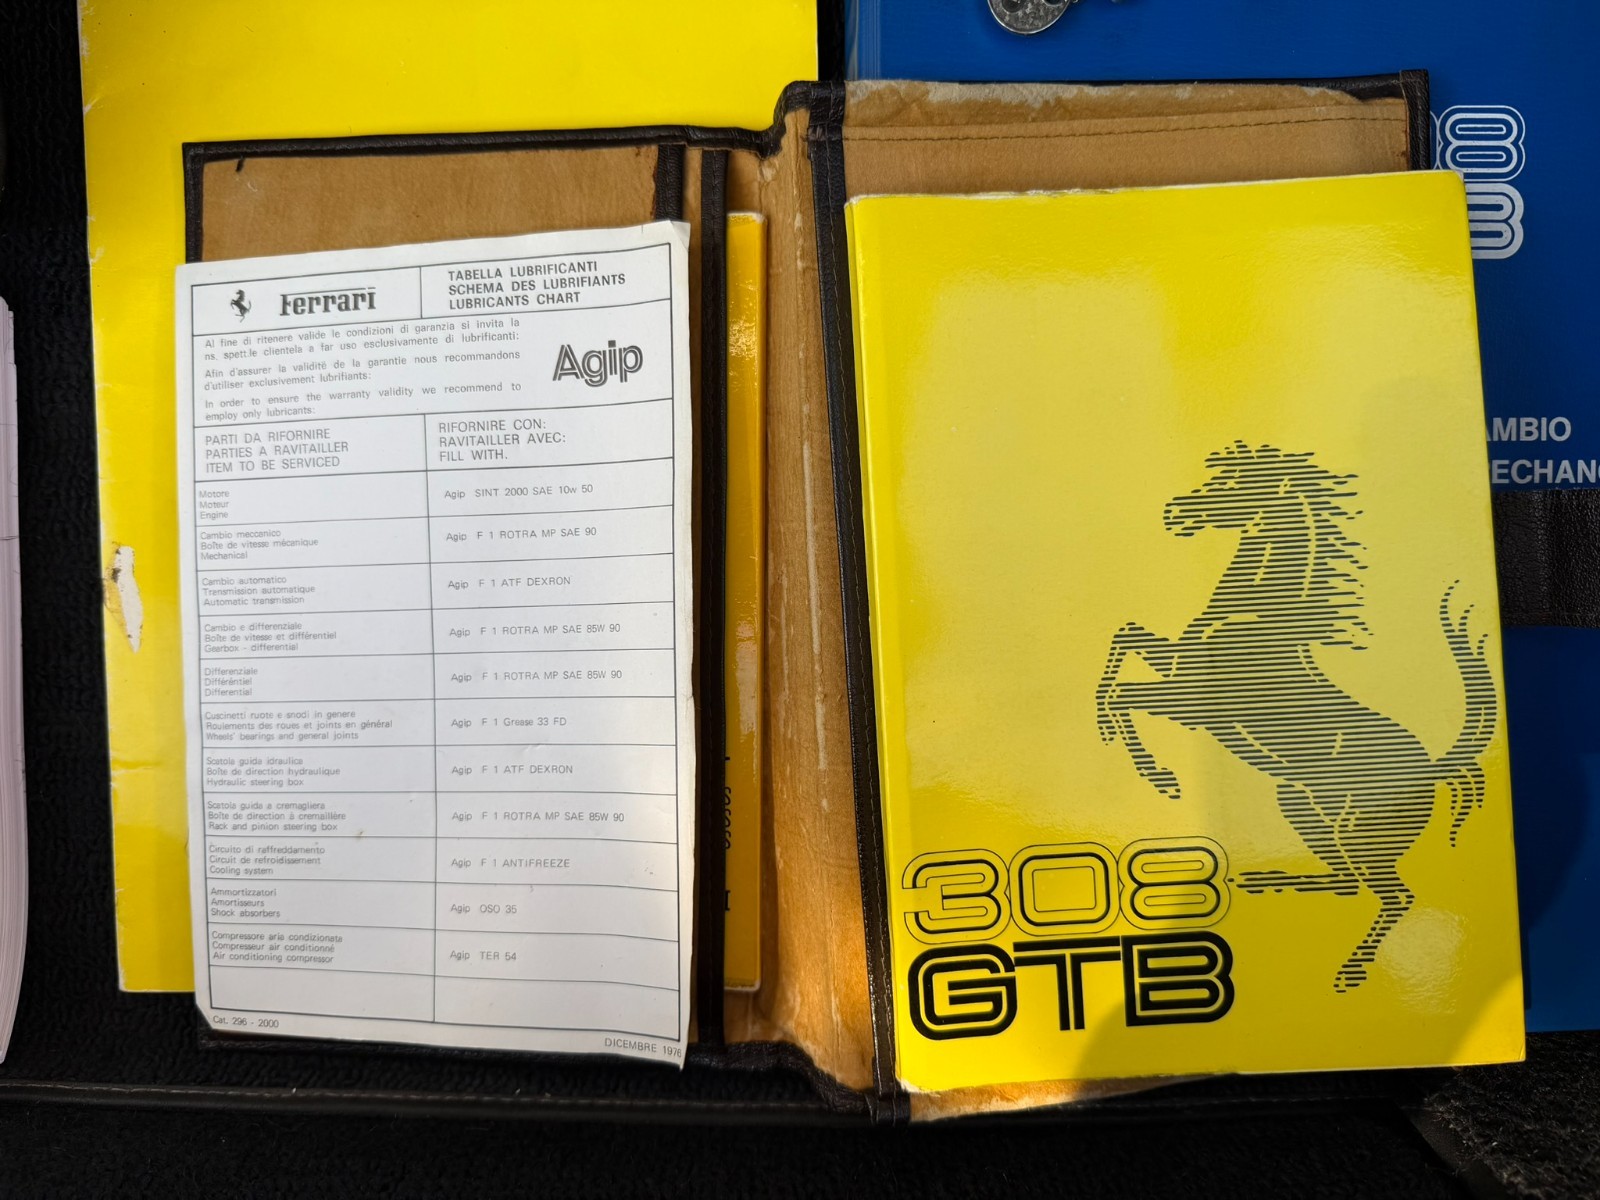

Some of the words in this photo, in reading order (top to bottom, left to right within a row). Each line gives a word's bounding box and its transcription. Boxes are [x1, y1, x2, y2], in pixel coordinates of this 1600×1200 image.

[448, 268, 503, 280] TABELLA
[510, 261, 597, 277] LUBRIFICANTI
[449, 283, 504, 295] SCHEMA
[512, 280, 536, 291] DES
[544, 274, 626, 289] LUBRIFIANTS
[280, 287, 376, 316] Ferrari
[450, 295, 529, 309] LUBRICANTS
[537, 292, 580, 304] CHART
[205, 340, 215, 348] Al
[243, 337, 251, 345] di
[257, 335, 293, 344] ritenere
[298, 331, 326, 340] valide
[332, 330, 340, 338] le
[346, 326, 394, 337] condizioni
[400, 325, 409, 333] di
[415, 322, 455, 334] garanzia
[462, 321, 470, 330] si
[477, 319, 504, 328] invita
[511, 318, 520, 327] la
[264, 345, 303, 356] clientela
[321, 343, 334, 351] far
[364, 337, 438, 348] esclusivamente
[445, 335, 454, 343] di
[462, 332, 519, 342] lubrificanti:
[205, 369, 224, 378] Afin
[230, 368, 272, 376] d'assurer
[279, 364, 287, 373] la
[334, 360, 345, 369] de
[368, 357, 407, 368] garantie
[445, 351, 520, 362] recommandons
[552, 340, 644, 387] Agip
[204, 381, 244, 390] d'utiliser
[248, 376, 315, 387] exclusivement
[320, 372, 371, 382] lubrifiants:
[205, 400, 214, 408] In
[220, 398, 244, 407] order
[268, 396, 299, 404] ensure
[306, 393, 322, 401] the
[329, 391, 370, 399] warranty
[379, 388, 414, 397] validity
[444, 383, 503, 393] recommend
[511, 383, 522, 391] to
[205, 411, 238, 421] employ
[242, 409, 262, 419] only
[267, 407, 315, 416] lubricants:
[439, 420, 506, 432] RIFORNIRE
[513, 419, 546, 430] CON:
[206, 434, 238, 445] PARTI
[244, 433, 262, 444] DA
[268, 429, 330, 441] RIFORNIRE
[440, 434, 520, 447] RAVITAILLER
[527, 432, 566, 444] AVEC:
[206, 447, 253, 459] PARTIES
[259, 446, 268, 456] A
[274, 442, 349, 455] RAVITAILLER
[440, 451, 464, 462] FILL
[207, 462, 233, 473] ITEM
[239, 461, 255, 471] TO
[261, 460, 276, 470] BE
[281, 456, 340, 469] SERVICED
[1491, 459, 1600, 484] ECHAN
[444, 490, 466, 500] Agip
[475, 488, 500, 497] SINT
[505, 487, 529, 496] 2000
[533, 486, 552, 495] SAE
[582, 484, 593, 493] 50
[200, 511, 228, 520] Engine
[200, 531, 233, 540] Cambio
[446, 533, 467, 542] Agip
[500, 530, 537, 539] ROTRA
[542, 529, 556, 537] MP
[561, 528, 580, 537] SAE
[585, 527, 597, 536] 90
[200, 551, 248, 560] Mechanical
[448, 580, 469, 590] Agip
[501, 578, 522, 587] ATF
[527, 577, 570, 586] DEXRON
[202, 587, 258, 596] Transmission
[261, 586, 315, 594] automatique
[203, 598, 248, 606] Automatic
[252, 596, 305, 605] transmission
[204, 667, 258, 676] Differenziale
[205, 688, 252, 696] Differential
[451, 719, 472, 728] Agip
[503, 718, 534, 726] Grease
[537, 717, 549, 726] 33
[554, 717, 567, 726] FD
[206, 778, 246, 786] Hydraulic
[250, 778, 284, 788] steering
[208, 822, 228, 830] Rack
[231, 823, 248, 831] and
[251, 822, 279, 832] pinion
[283, 823, 317, 832] steering
[320, 823, 338, 831] box
[208, 845, 242, 854] Circuito
[257, 846, 325, 854] raffreddamento
[209, 855, 237, 864] Circuit
[254, 856, 321, 864] refroidissement
[451, 858, 471, 868] Agip
[502, 859, 570, 868] ANTIFREEZE
[209, 866, 241, 876] Cooling
[210, 888, 277, 896] Ammortizzatori
[902, 835, 1231, 944] 308
[211, 898, 265, 907] Amortisseurs
[450, 904, 470, 914] Agip
[480, 904, 500, 914] OSO
[506, 905, 517, 914] 35
[211, 908, 235, 917] Shock
[240, 909, 281, 918] absorbers
[229, 953, 282, 963] conditioning
[286, 955, 334, 964] compressor
[450, 950, 470, 961] Agip
[480, 951, 500, 960] TER
[505, 952, 517, 962] 54
[908, 930, 1236, 1040] GTB
[212, 1015, 228, 1024] Cat.
[258, 1019, 279, 1028] 2000
[605, 1038, 657, 1052] DICEMBRE
